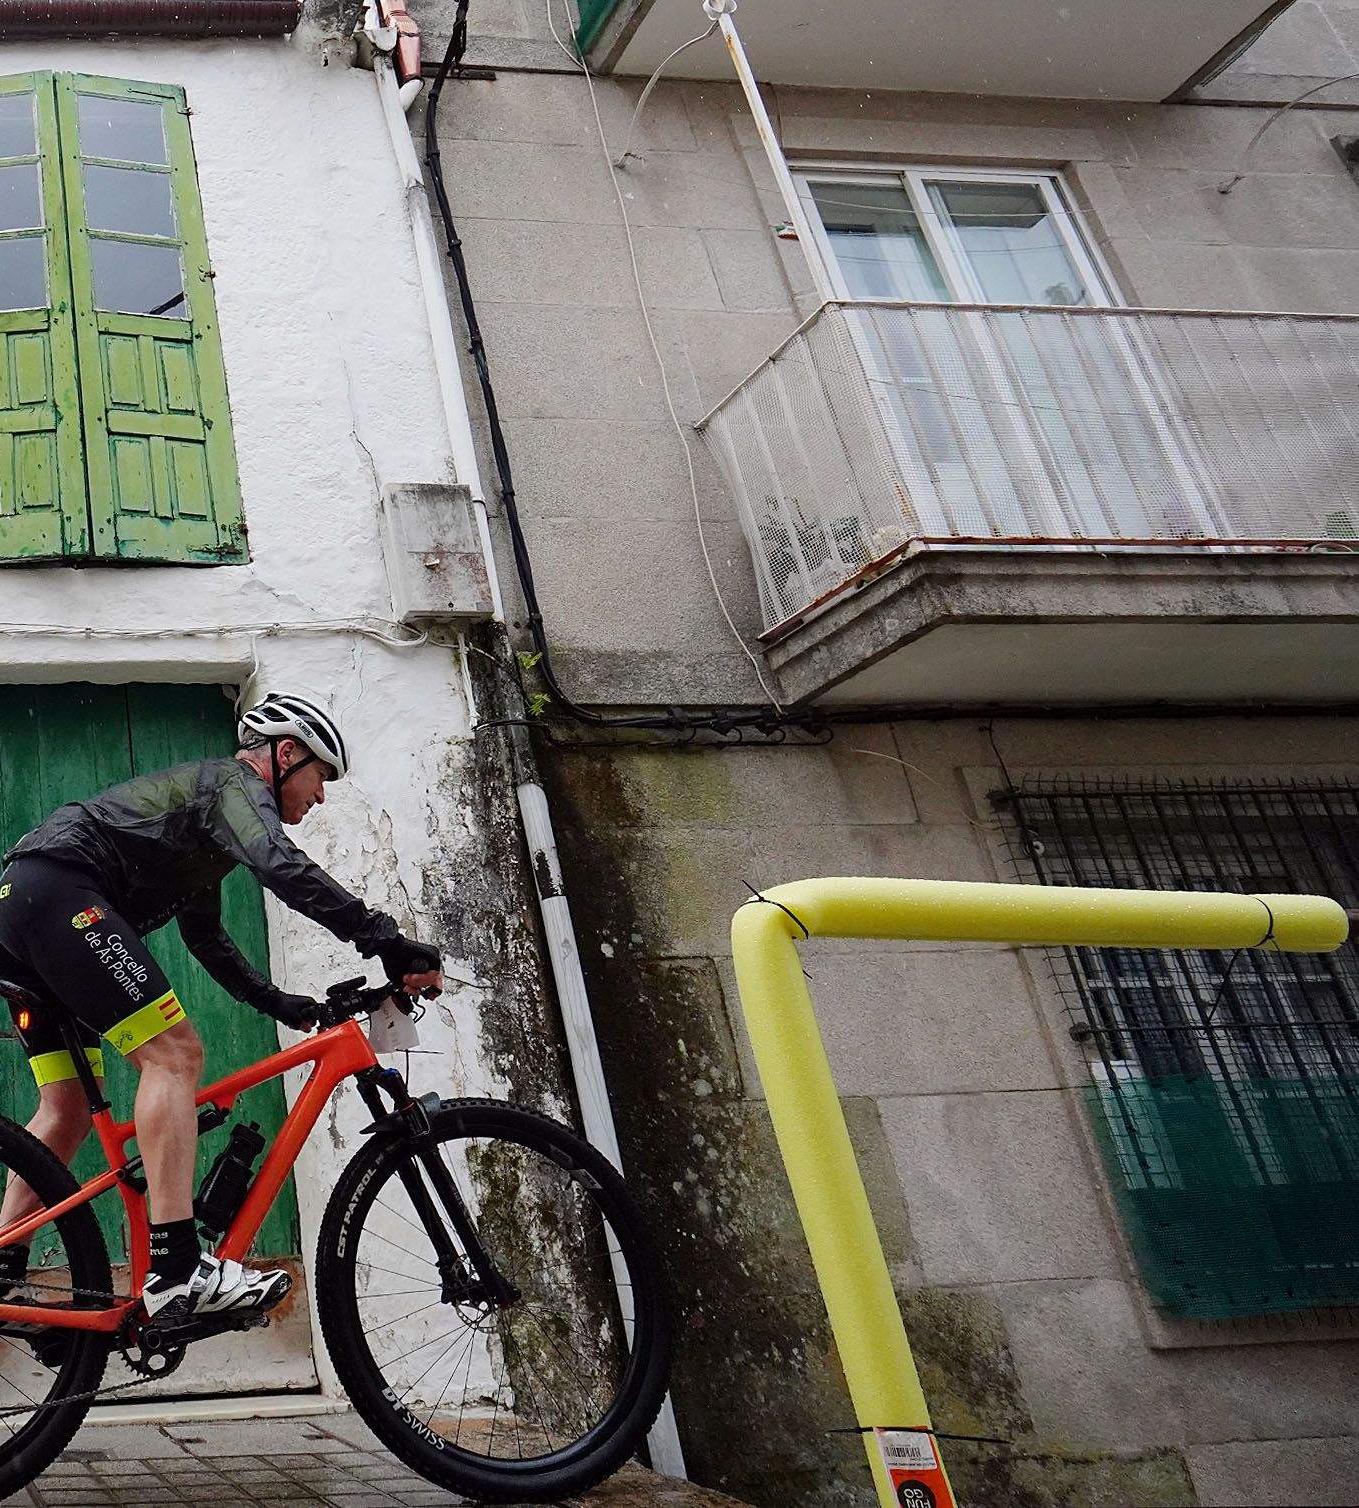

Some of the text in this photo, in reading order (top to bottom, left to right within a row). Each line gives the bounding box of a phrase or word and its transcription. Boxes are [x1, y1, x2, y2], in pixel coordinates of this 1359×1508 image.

[84, 931, 144, 1001] de As Pontes
[107, 934, 148, 982] Concello
[381, 1386, 446, 1451] DT SWISS
[903, 1488, 924, 1499] GO
